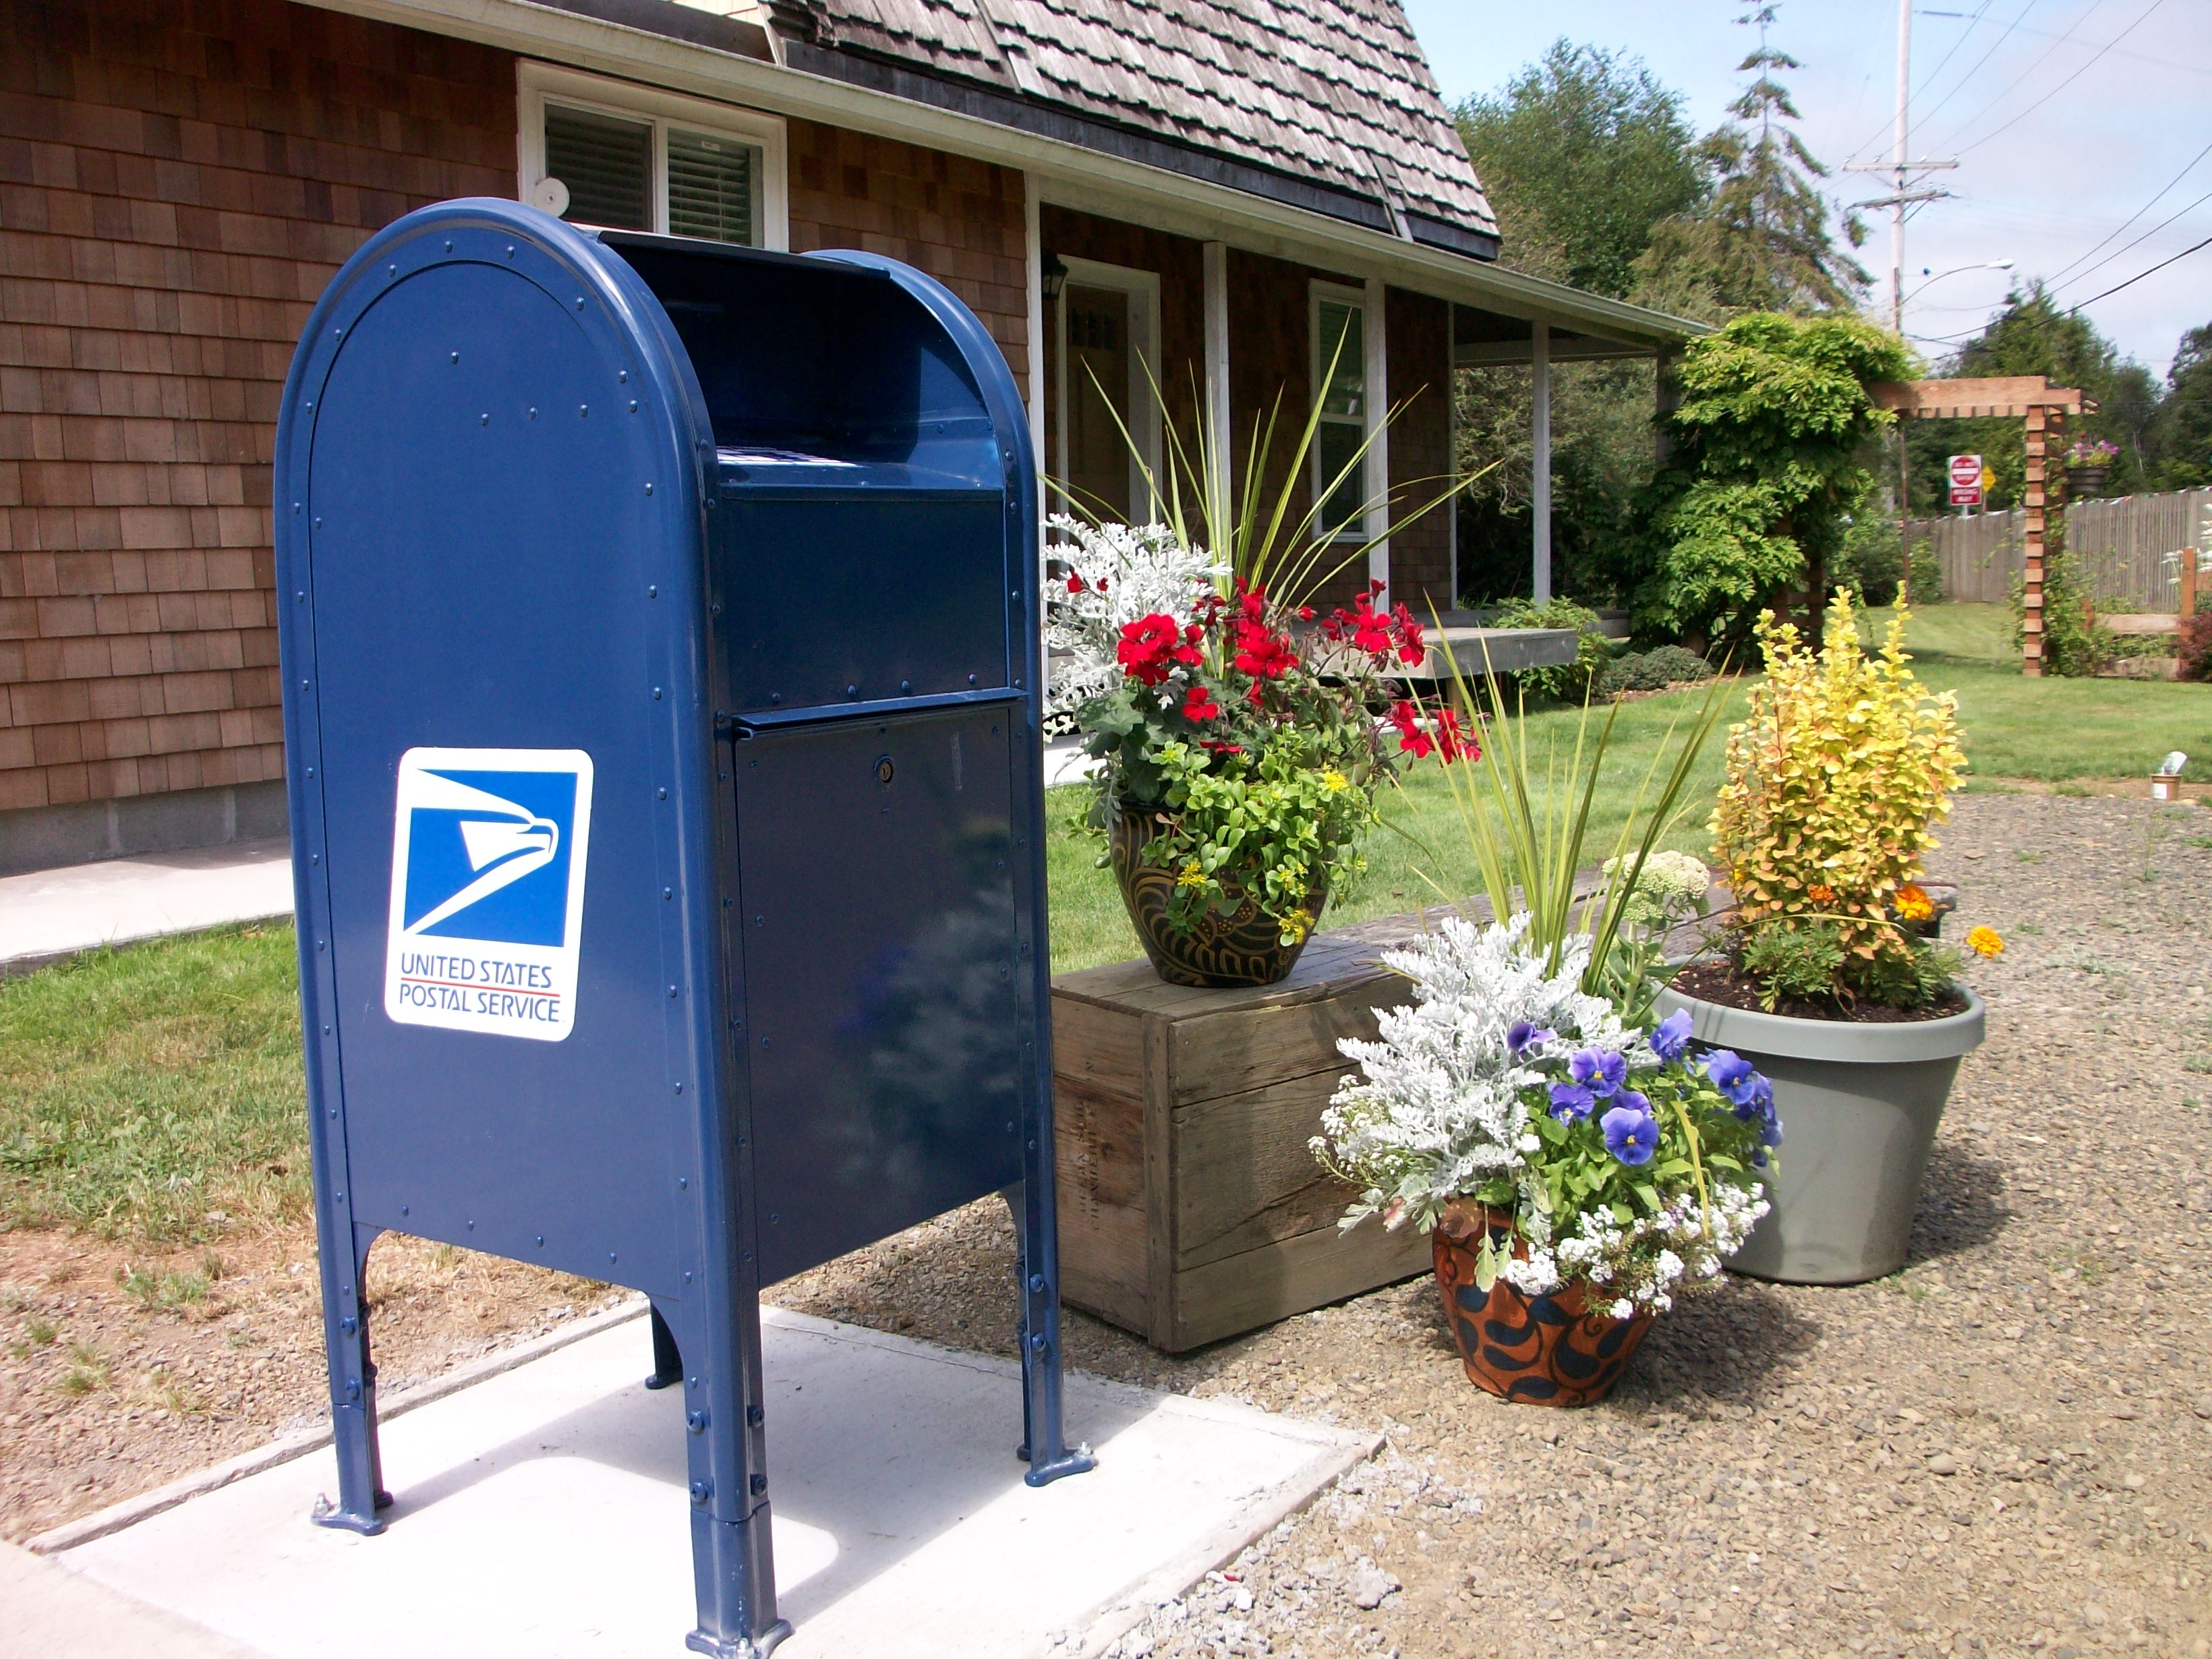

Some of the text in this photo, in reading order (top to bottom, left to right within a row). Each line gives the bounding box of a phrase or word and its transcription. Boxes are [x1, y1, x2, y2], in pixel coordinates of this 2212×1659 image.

[401, 952, 552, 989] UNITED STATES
[400, 983, 561, 1022] POSTAL SERVICE
